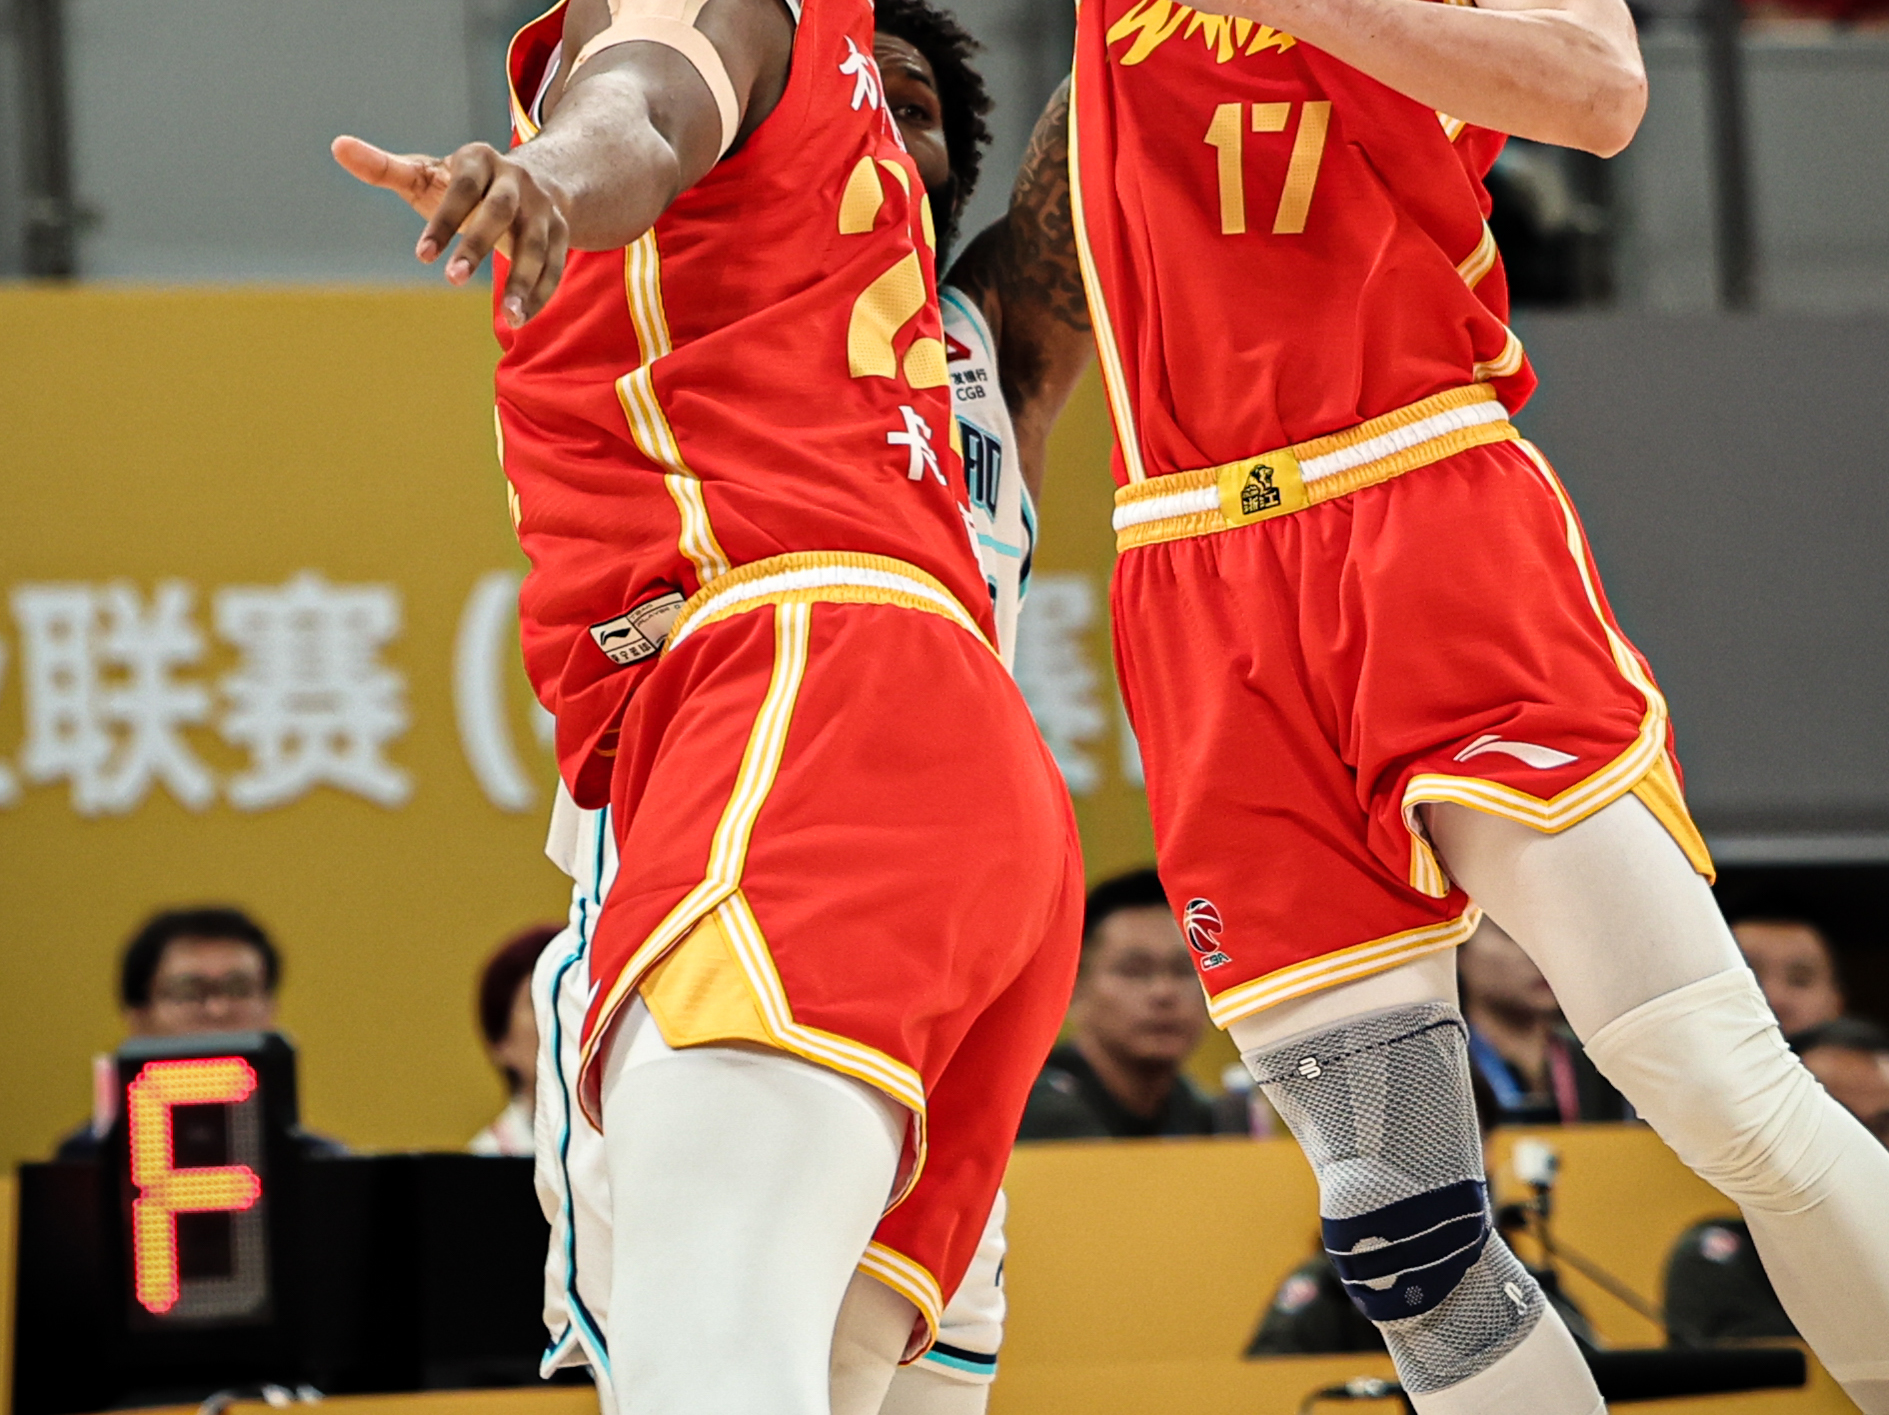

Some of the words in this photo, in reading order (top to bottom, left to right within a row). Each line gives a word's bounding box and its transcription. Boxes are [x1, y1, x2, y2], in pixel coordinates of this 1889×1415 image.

[1203, 100, 1332, 235] 17
[956, 385, 986, 402] CGB
[128, 1054, 262, 1315] F
